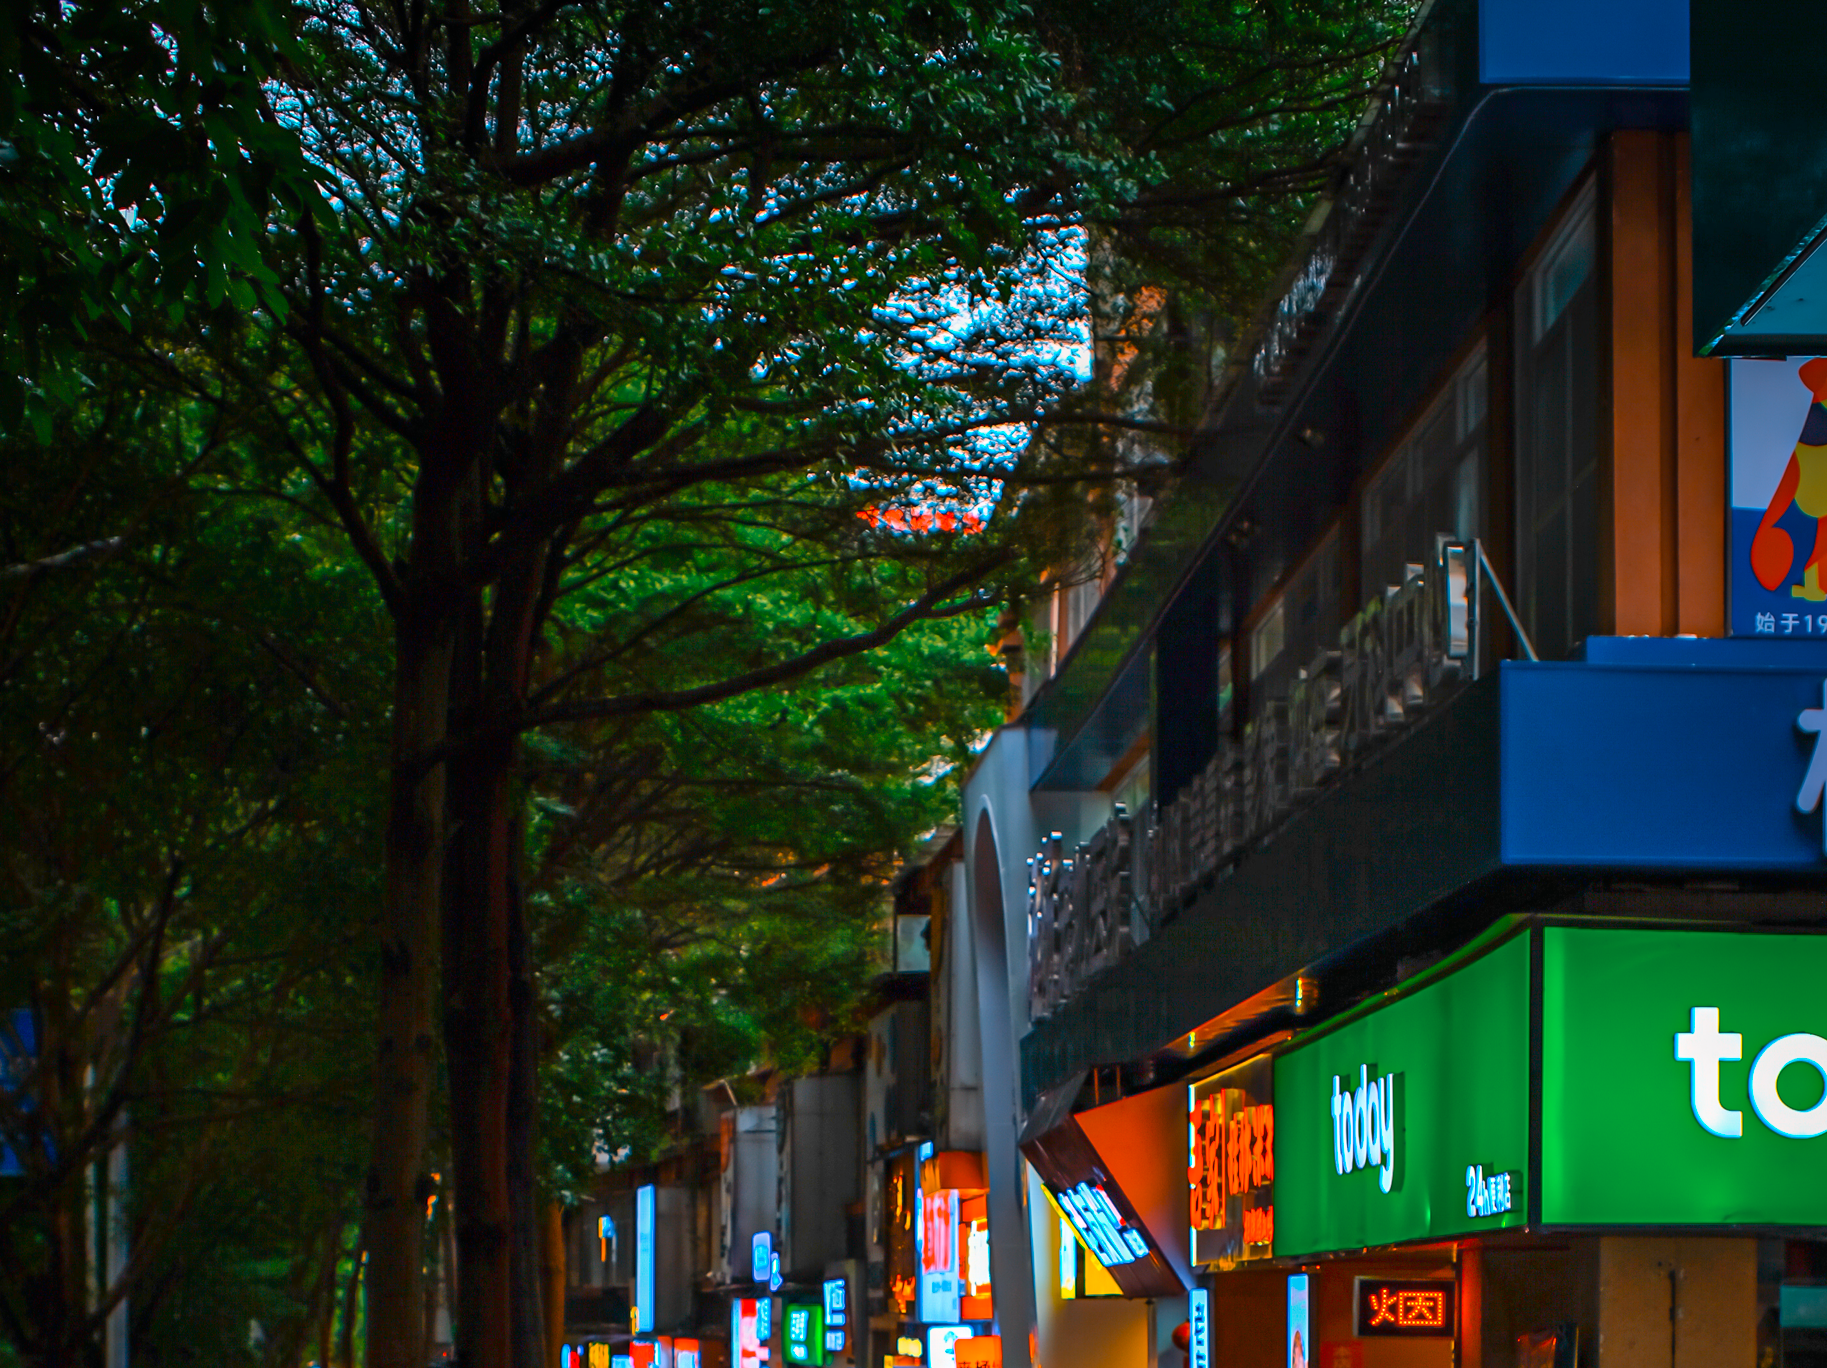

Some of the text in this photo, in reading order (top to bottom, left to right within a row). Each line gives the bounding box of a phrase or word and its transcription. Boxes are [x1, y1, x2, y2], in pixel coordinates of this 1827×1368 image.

[1331, 1063, 1394, 1194] today
[1674, 1006, 1827, 1139] to
[1368, 1287, 1446, 1328] 烟
